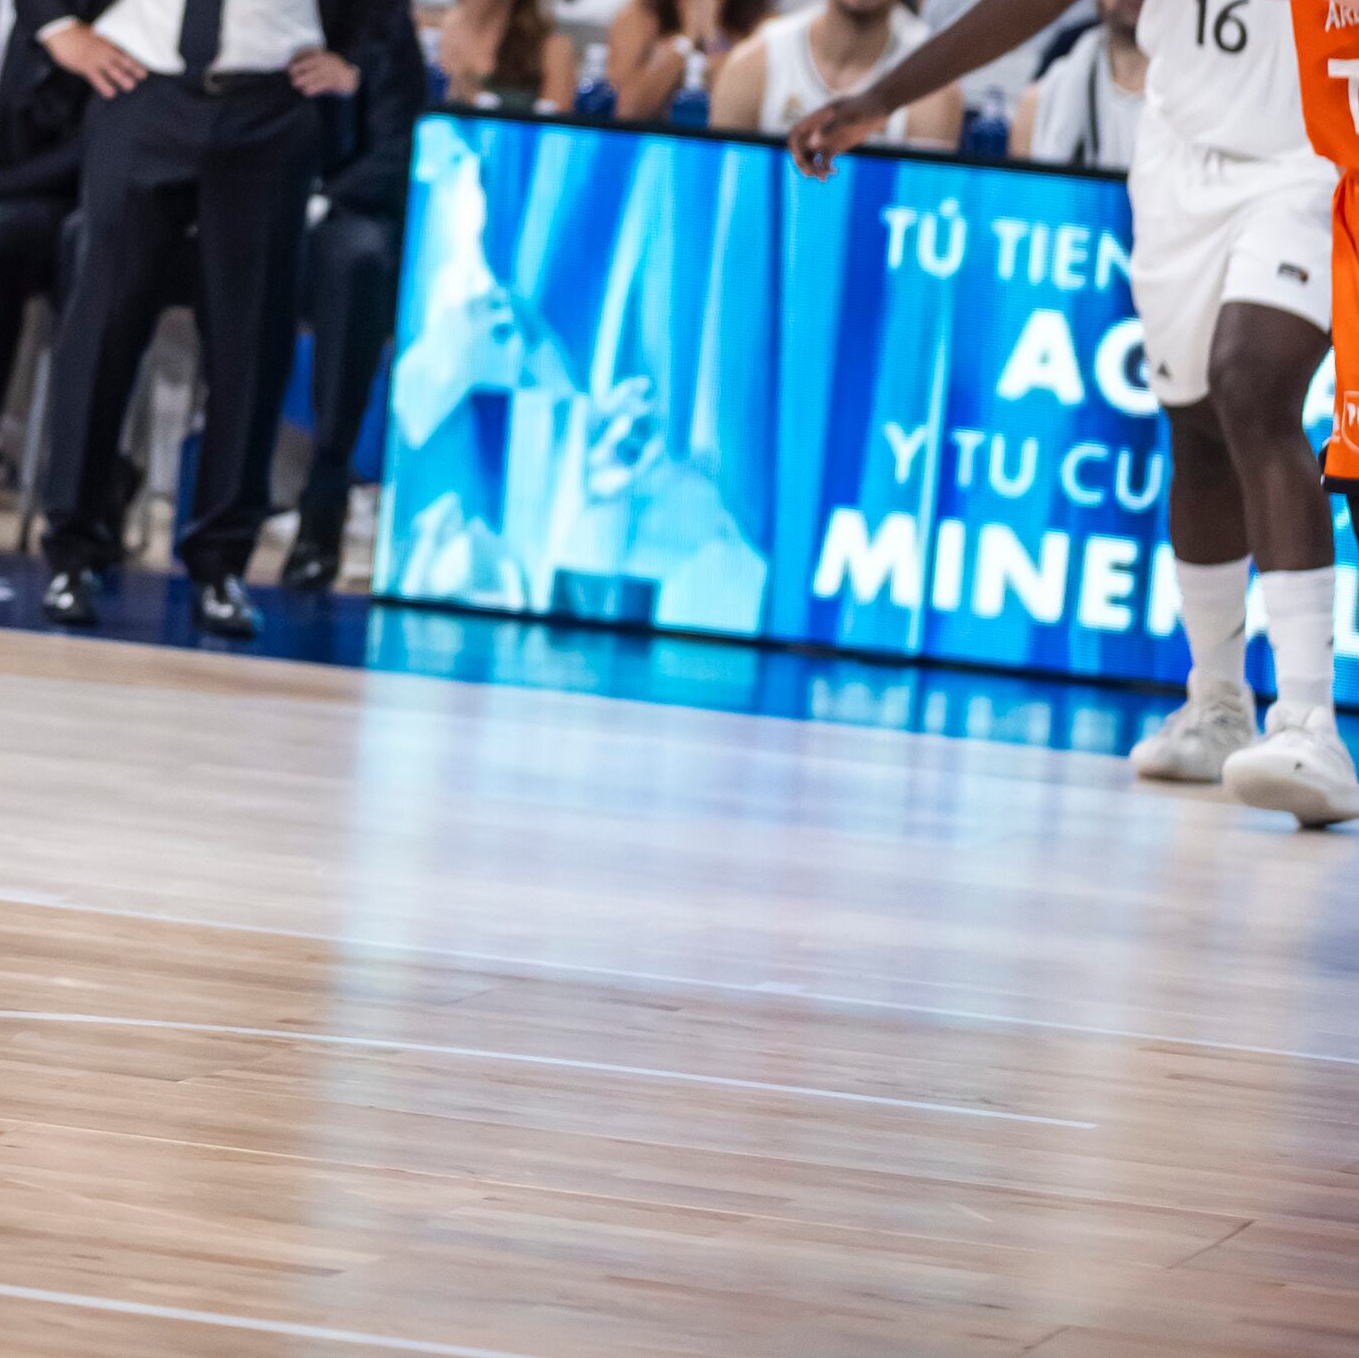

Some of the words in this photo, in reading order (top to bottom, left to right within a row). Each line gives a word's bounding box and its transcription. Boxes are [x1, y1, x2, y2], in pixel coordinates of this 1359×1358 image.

[882, 197, 967, 279] TÚ
[882, 421, 928, 485] Y
[953, 429, 1038, 498] TU
